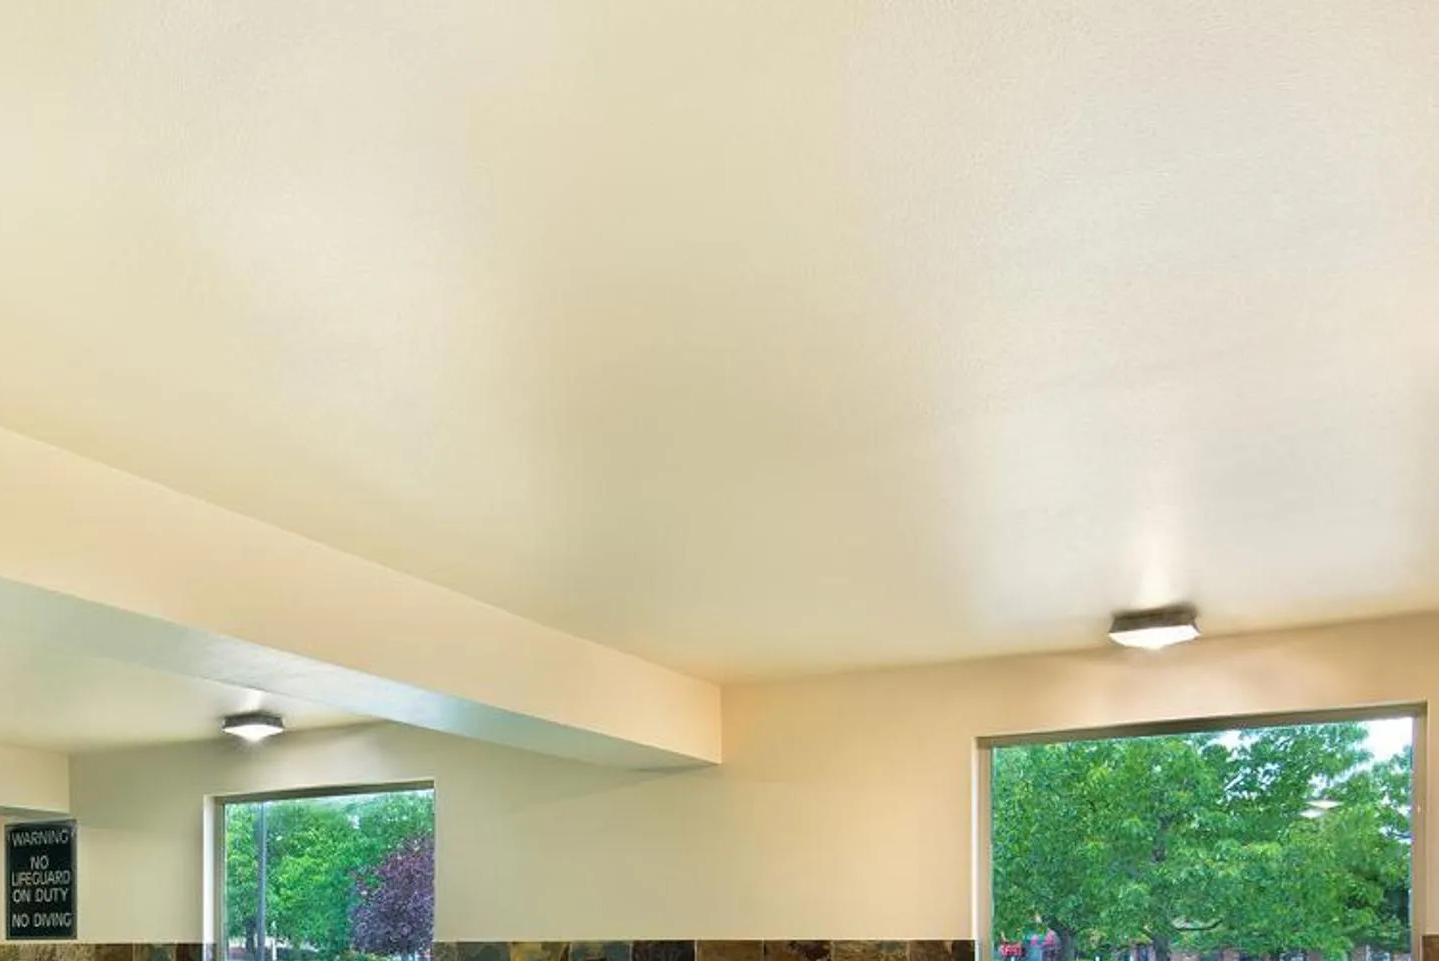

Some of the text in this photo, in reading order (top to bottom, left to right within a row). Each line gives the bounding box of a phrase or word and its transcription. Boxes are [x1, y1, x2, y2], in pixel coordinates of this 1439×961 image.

[12, 831, 69, 846] WARNING
[29, 855, 49, 869] NO
[11, 870, 70, 886] LIFEGUARD
[12, 888, 68, 904] ON DUTY
[11, 913, 72, 927] NO DIVING
